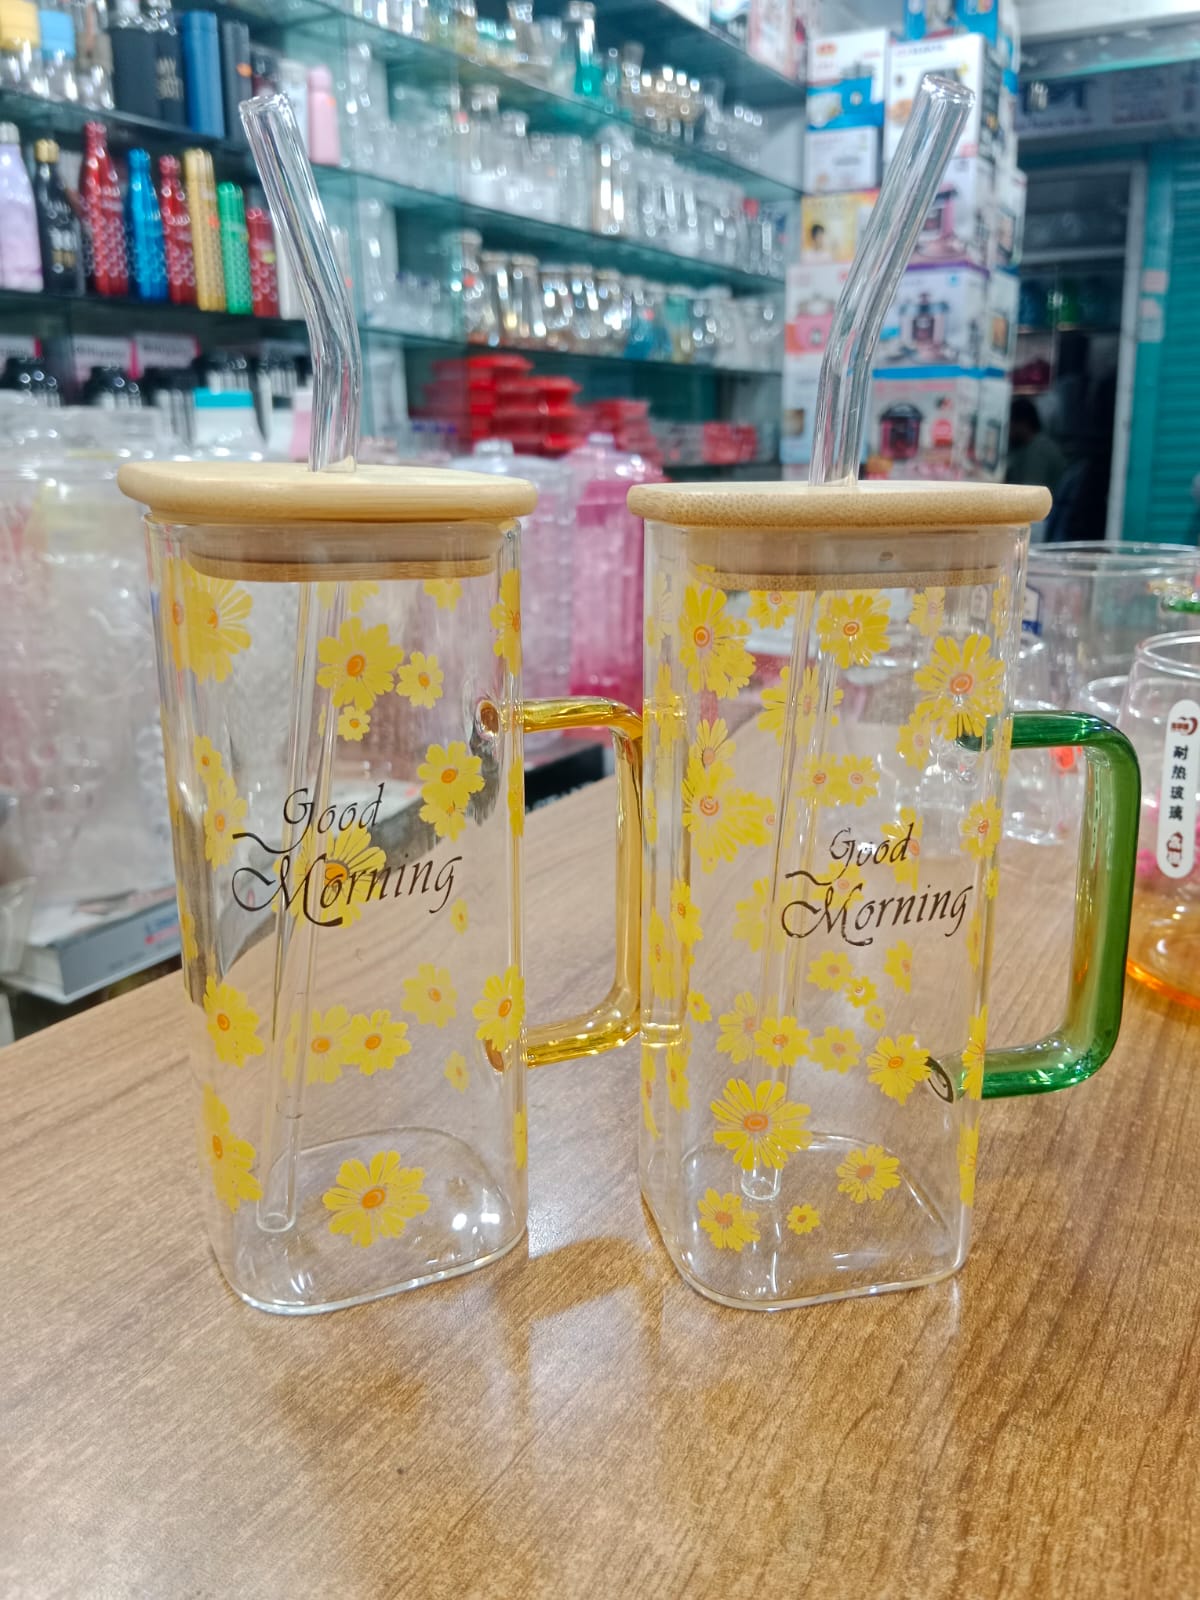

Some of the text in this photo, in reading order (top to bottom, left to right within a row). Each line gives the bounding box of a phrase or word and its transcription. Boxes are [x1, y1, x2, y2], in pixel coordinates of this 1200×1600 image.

[232, 782, 385, 854] Good
[1168, 744, 1189, 821] 耐热玻璃
[231, 852, 463, 927] Morning
[785, 822, 914, 886] Good
[781, 883, 974, 946] Morning
